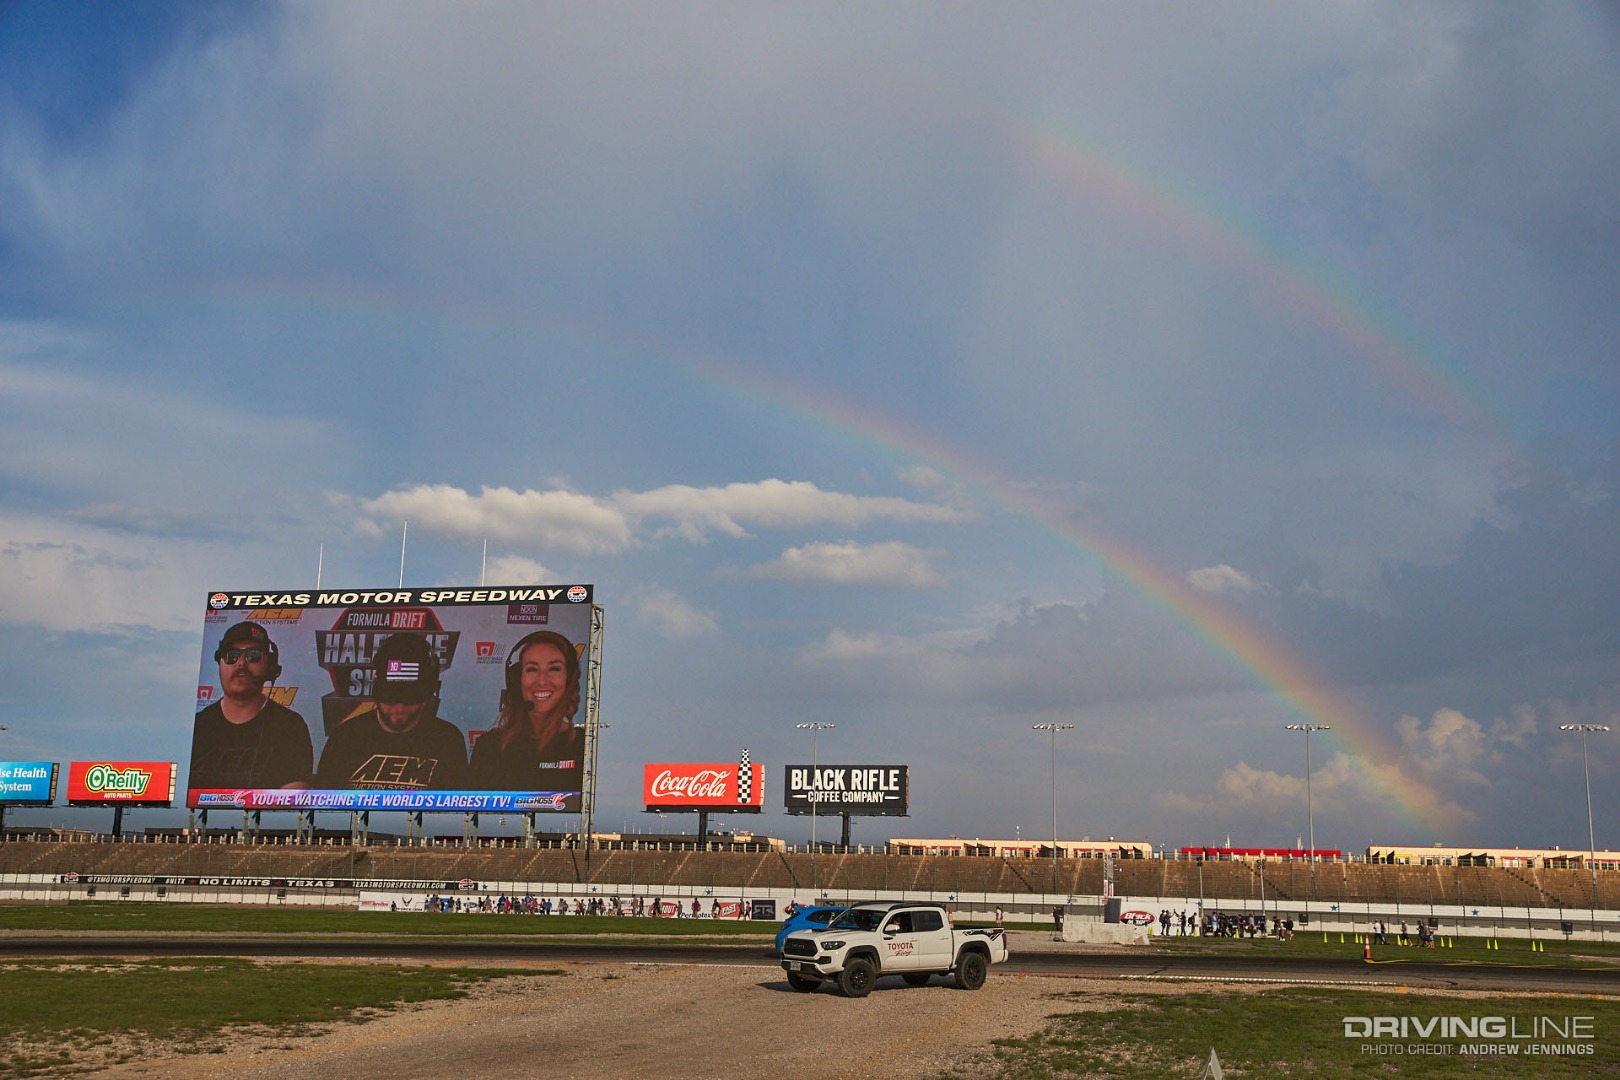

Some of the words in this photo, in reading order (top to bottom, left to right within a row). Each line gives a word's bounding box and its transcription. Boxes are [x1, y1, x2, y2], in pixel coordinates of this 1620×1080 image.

[232, 593, 311, 606] TEXAS
[317, 592, 412, 605] MOTOR
[419, 590, 564, 603] SPEEDWAY
[347, 612, 390, 627] FORMULA
[392, 612, 425, 628] DRIFT
[350, 754, 438, 787] AEM
[539, 761, 558, 769] FORMULA
[559, 760, 574, 768] DRIFT
[13, 767, 47, 778] Health
[88, 766, 148, 793] O'Reilly
[791, 769, 846, 790] BLACK
[851, 769, 899, 791] RIFLE
[0, 780, 32, 794] System
[651, 770, 731, 797] Coca-Cola
[252, 793, 291, 805] YOU'RE
[294, 794, 355, 806] WATCHING
[357, 794, 380, 806] THE
[382, 795, 434, 807] WORLD'S
[435, 796, 488, 807] LARGEST
[492, 796, 511, 808] TV!
[807, 791, 840, 803] COFFEE
[842, 791, 885, 803] COMPANY
[87, 876, 156, 884] @TXMOTORSPEEDWAY
[199, 878, 220, 886] NO
[352, 881, 447, 889] TEXASMOTORSPEEDWAY.COM
[888, 942, 914, 950] TOYOTA
